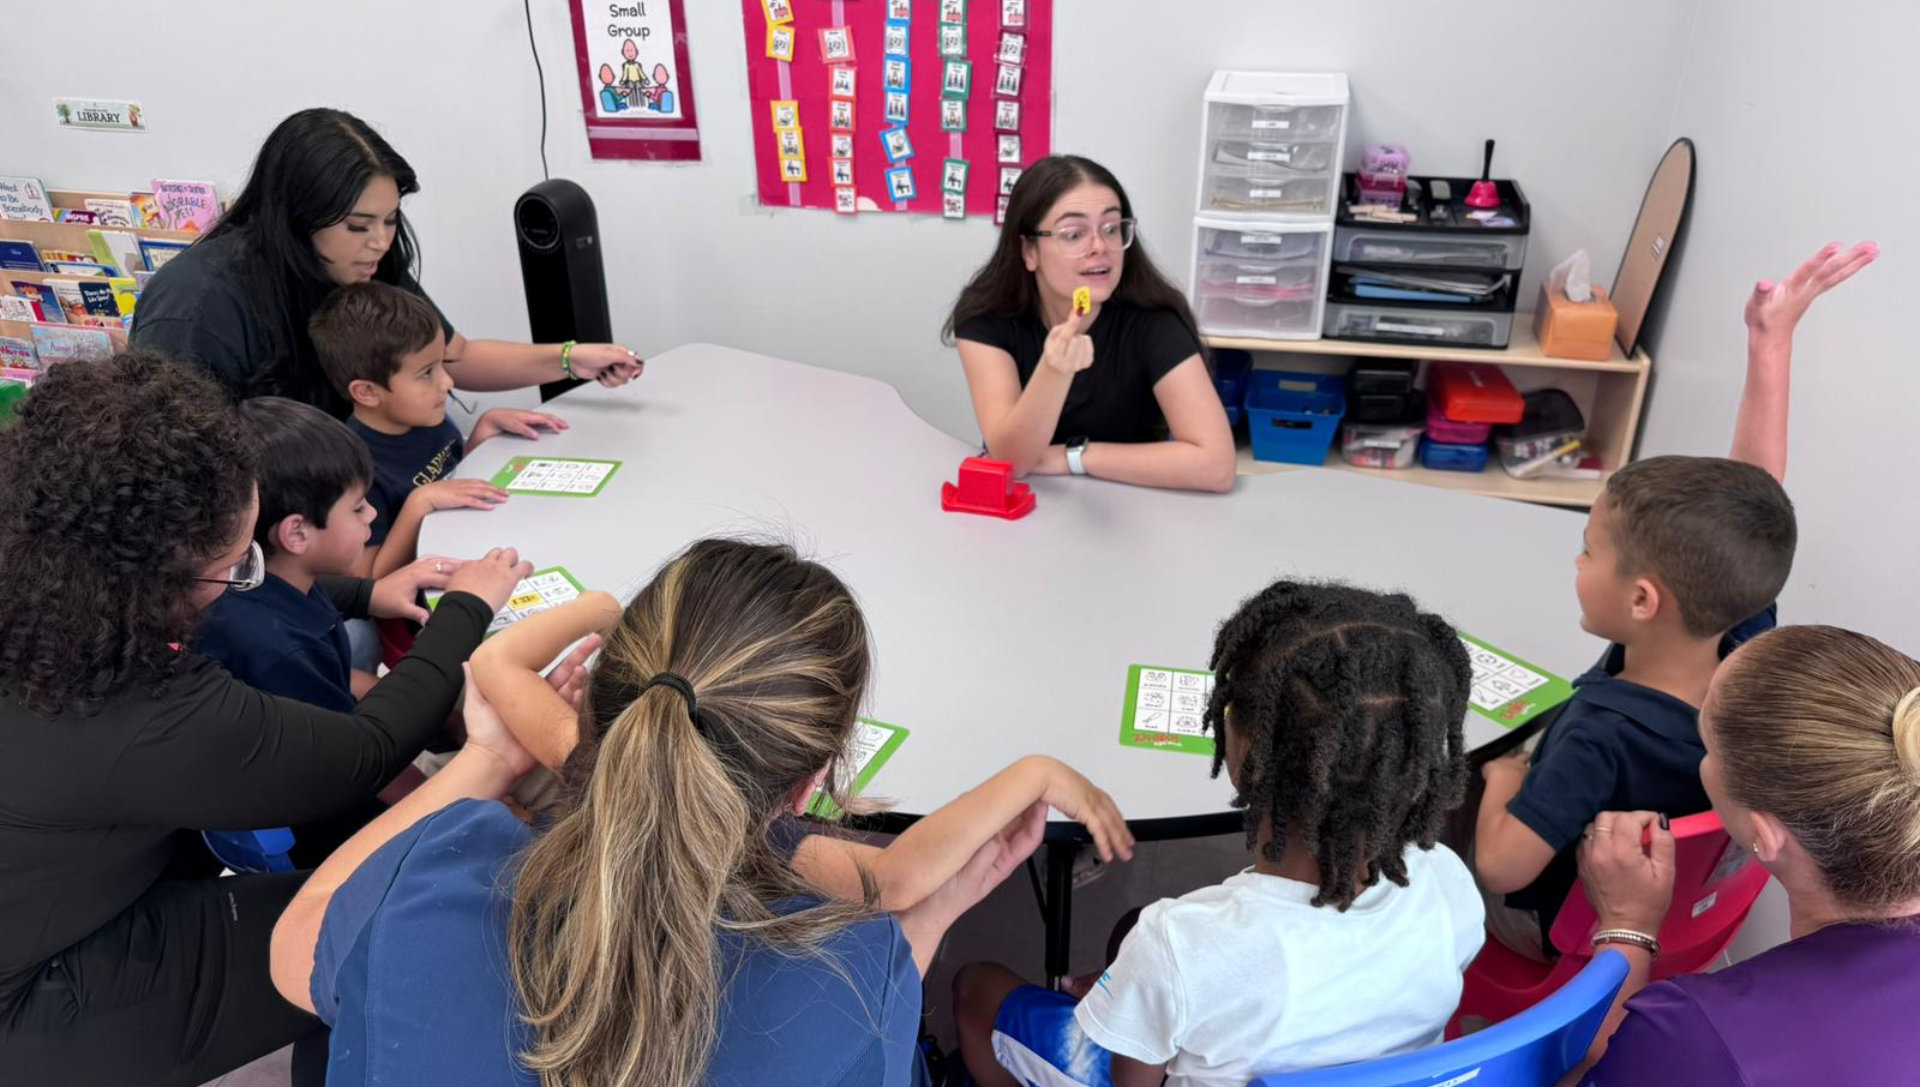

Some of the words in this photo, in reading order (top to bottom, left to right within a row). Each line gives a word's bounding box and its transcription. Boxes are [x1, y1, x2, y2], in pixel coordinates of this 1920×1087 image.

[609, 2, 647, 18] Small
[607, 24, 650, 40] Group
[77, 110, 120, 122] LIBRARY
